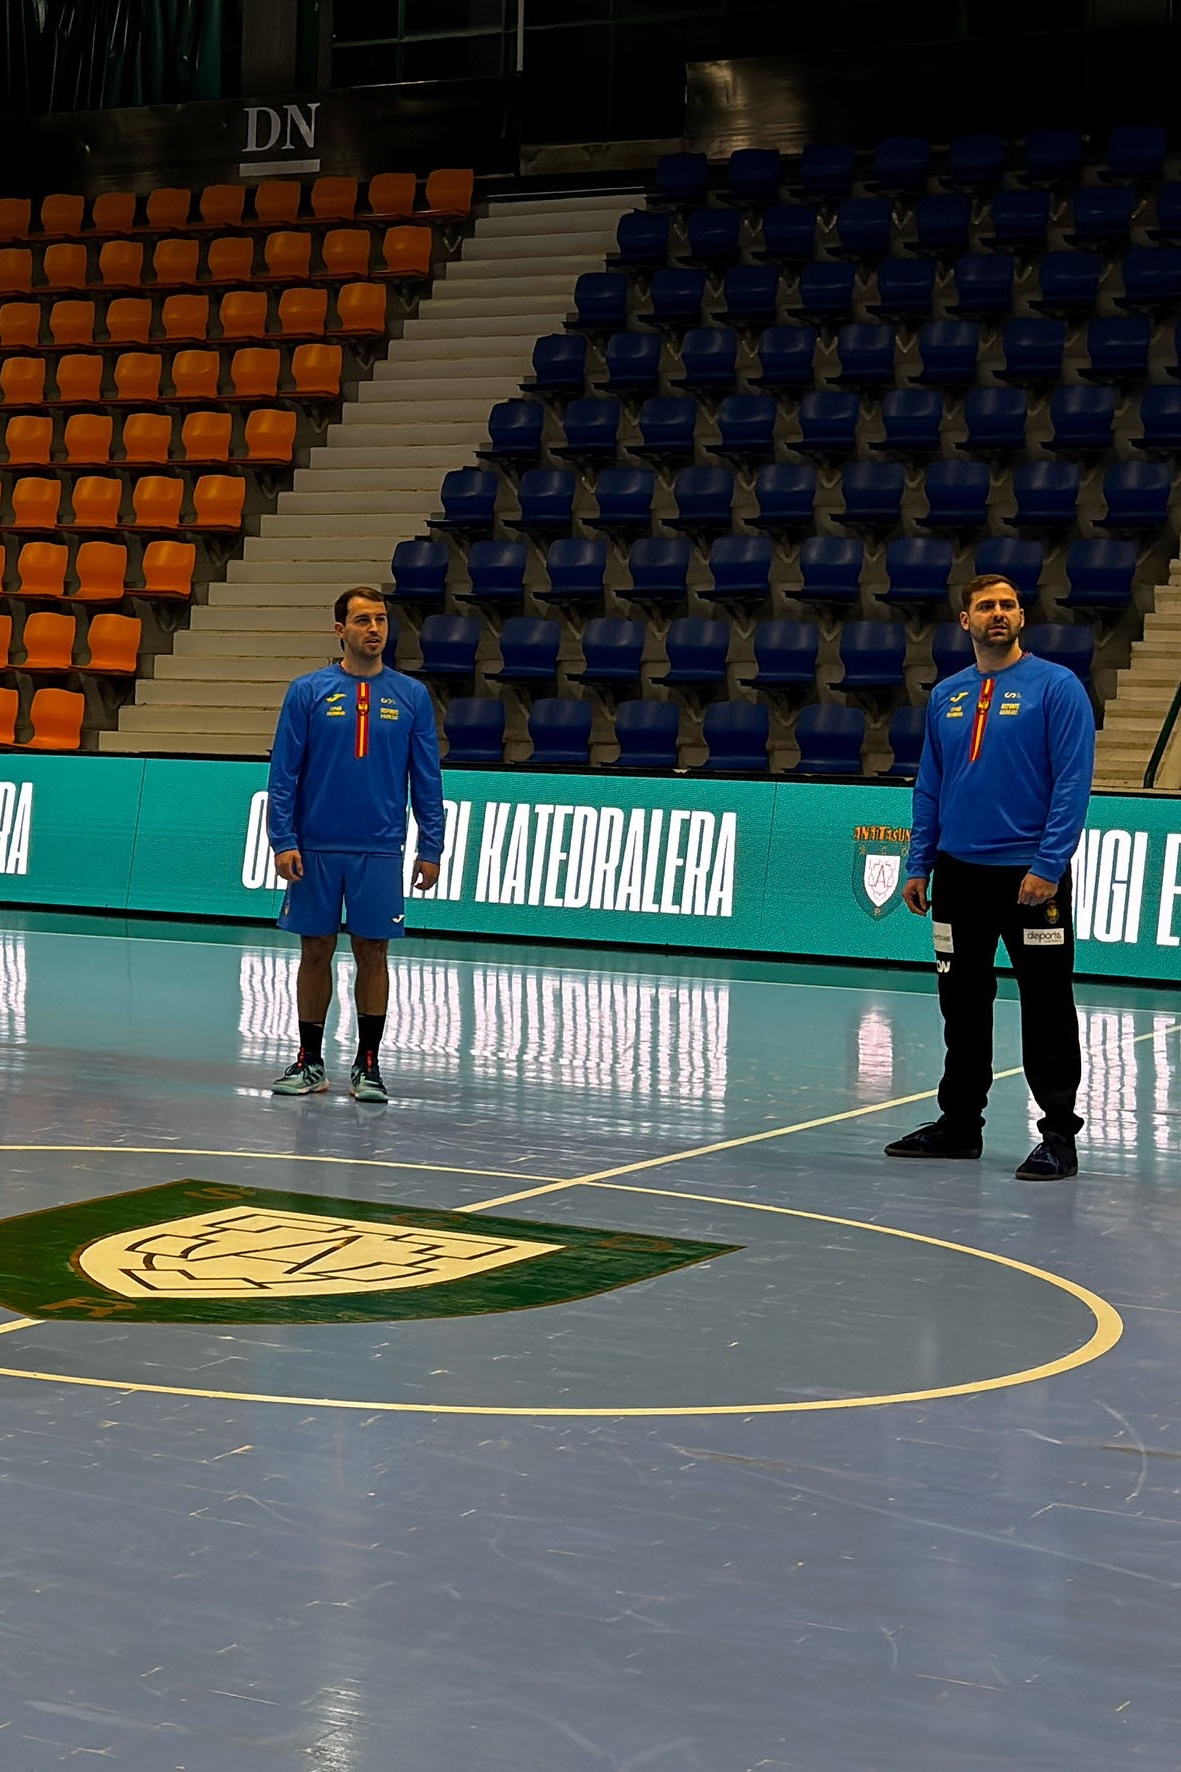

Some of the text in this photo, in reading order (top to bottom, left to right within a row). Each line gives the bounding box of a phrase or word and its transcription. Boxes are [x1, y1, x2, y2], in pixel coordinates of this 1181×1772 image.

[241, 101, 322, 152] DN
[475, 801, 737, 917] KATEDRALERA
[1072, 828, 1149, 943] NGI
